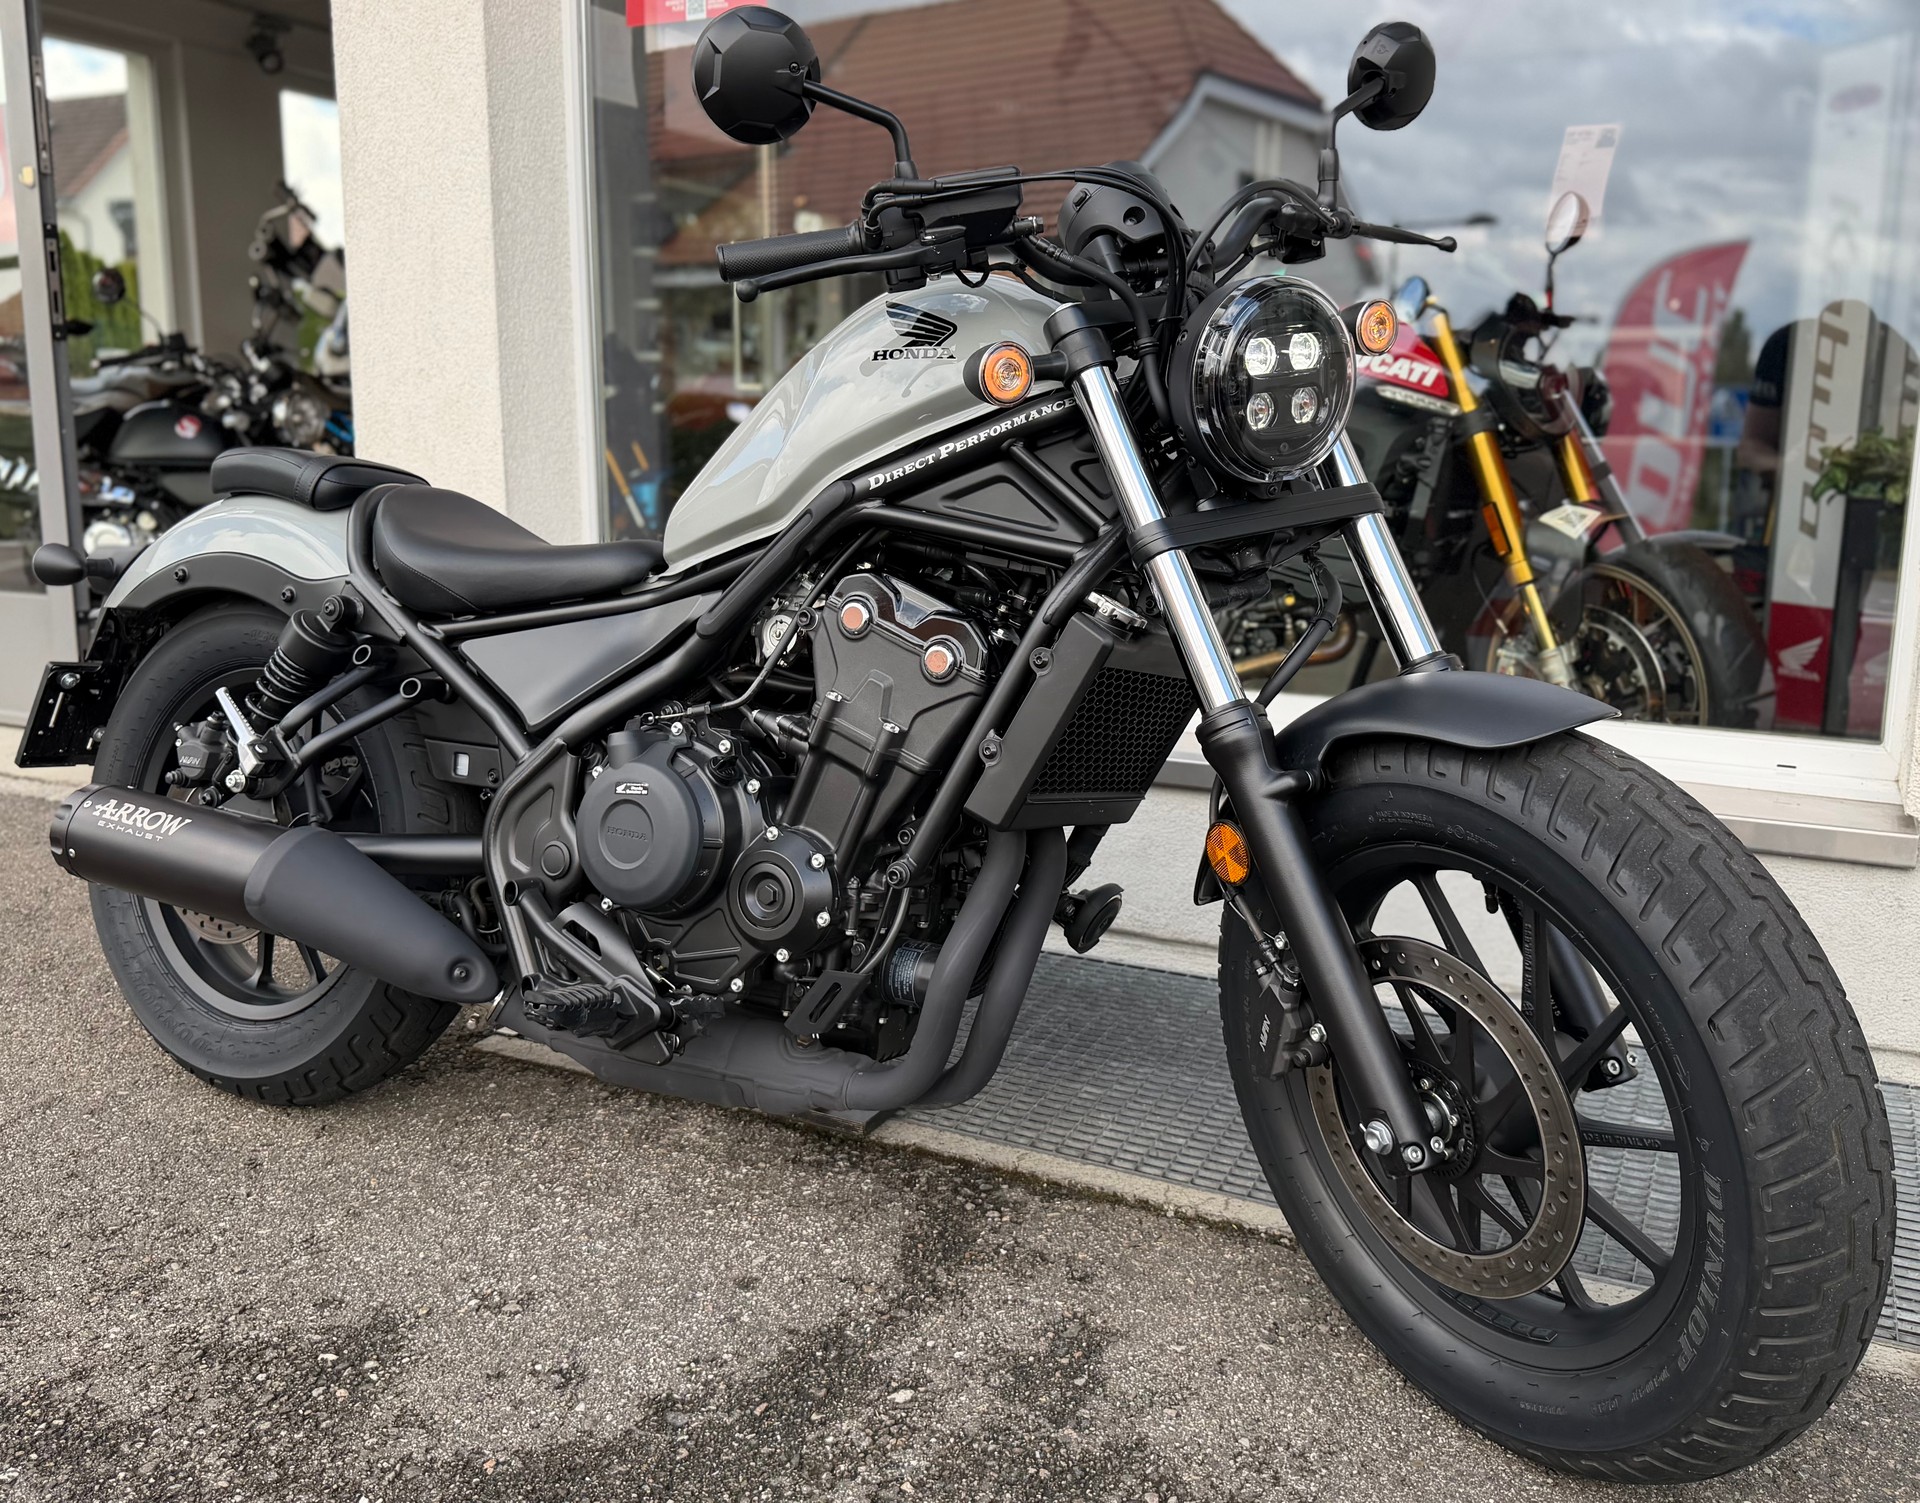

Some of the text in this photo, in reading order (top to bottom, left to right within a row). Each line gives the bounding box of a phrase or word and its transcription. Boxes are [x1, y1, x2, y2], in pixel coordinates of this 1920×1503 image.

[872, 347, 957, 361] HONDA
[1355, 352, 1439, 388] UCATI
[938, 397, 1077, 461] PERFORMANCE
[92, 799, 193, 836] ARROW
[97, 820, 164, 842] EXHAUST
[607, 826, 647, 841] HONDA
[1677, 1162, 1727, 1373] DUNLOP
